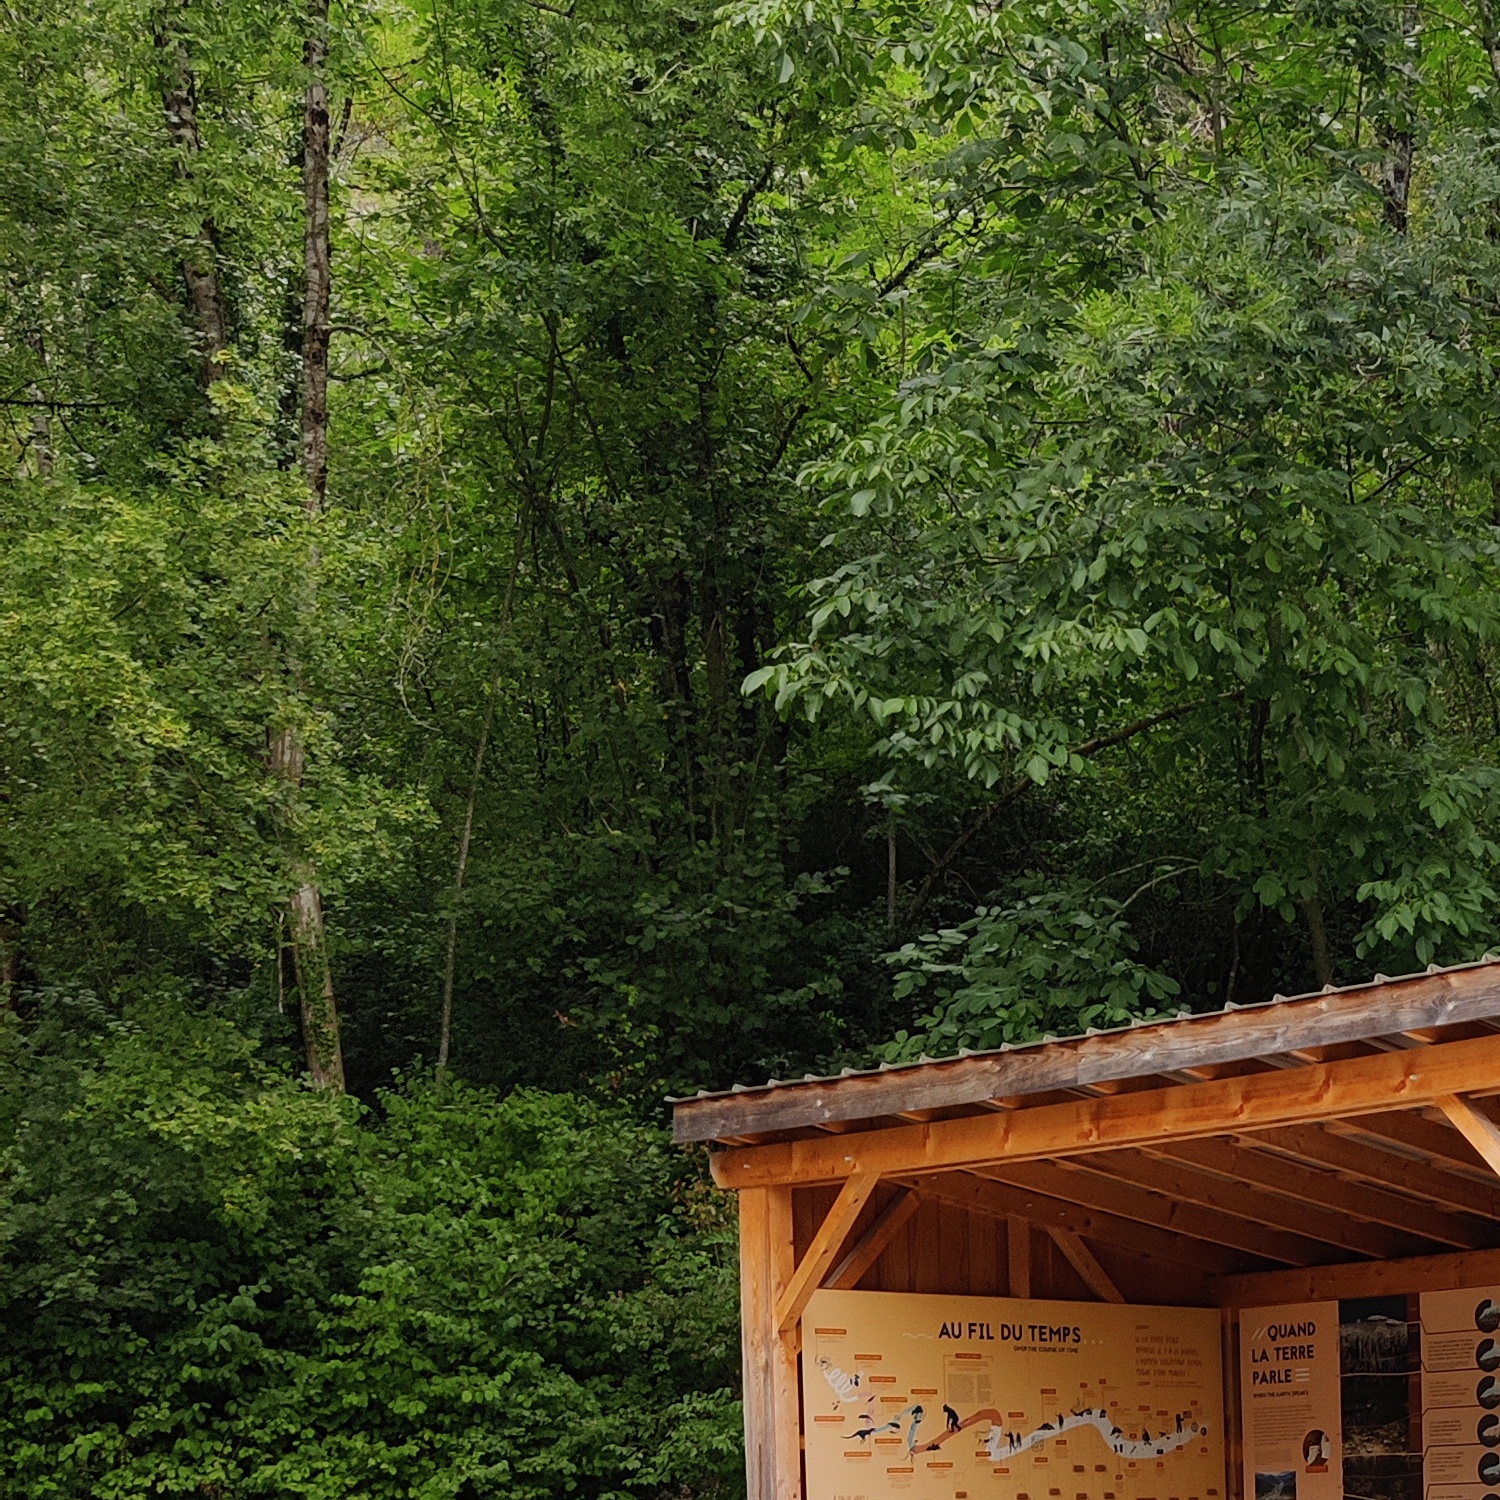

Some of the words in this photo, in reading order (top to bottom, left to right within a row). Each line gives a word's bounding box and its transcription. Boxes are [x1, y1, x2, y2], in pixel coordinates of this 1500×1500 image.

[938, 1322, 962, 1339] AU
[968, 1323, 995, 1340] FIL
[1001, 1324, 1023, 1341] DU
[1028, 1325, 1081, 1343] TEMPS
[1268, 1322, 1316, 1341] QUAND
[1252, 1349, 1269, 1363] LA
[1274, 1345, 1314, 1361] TERRE
[1253, 1369, 1292, 1386] PARLE
